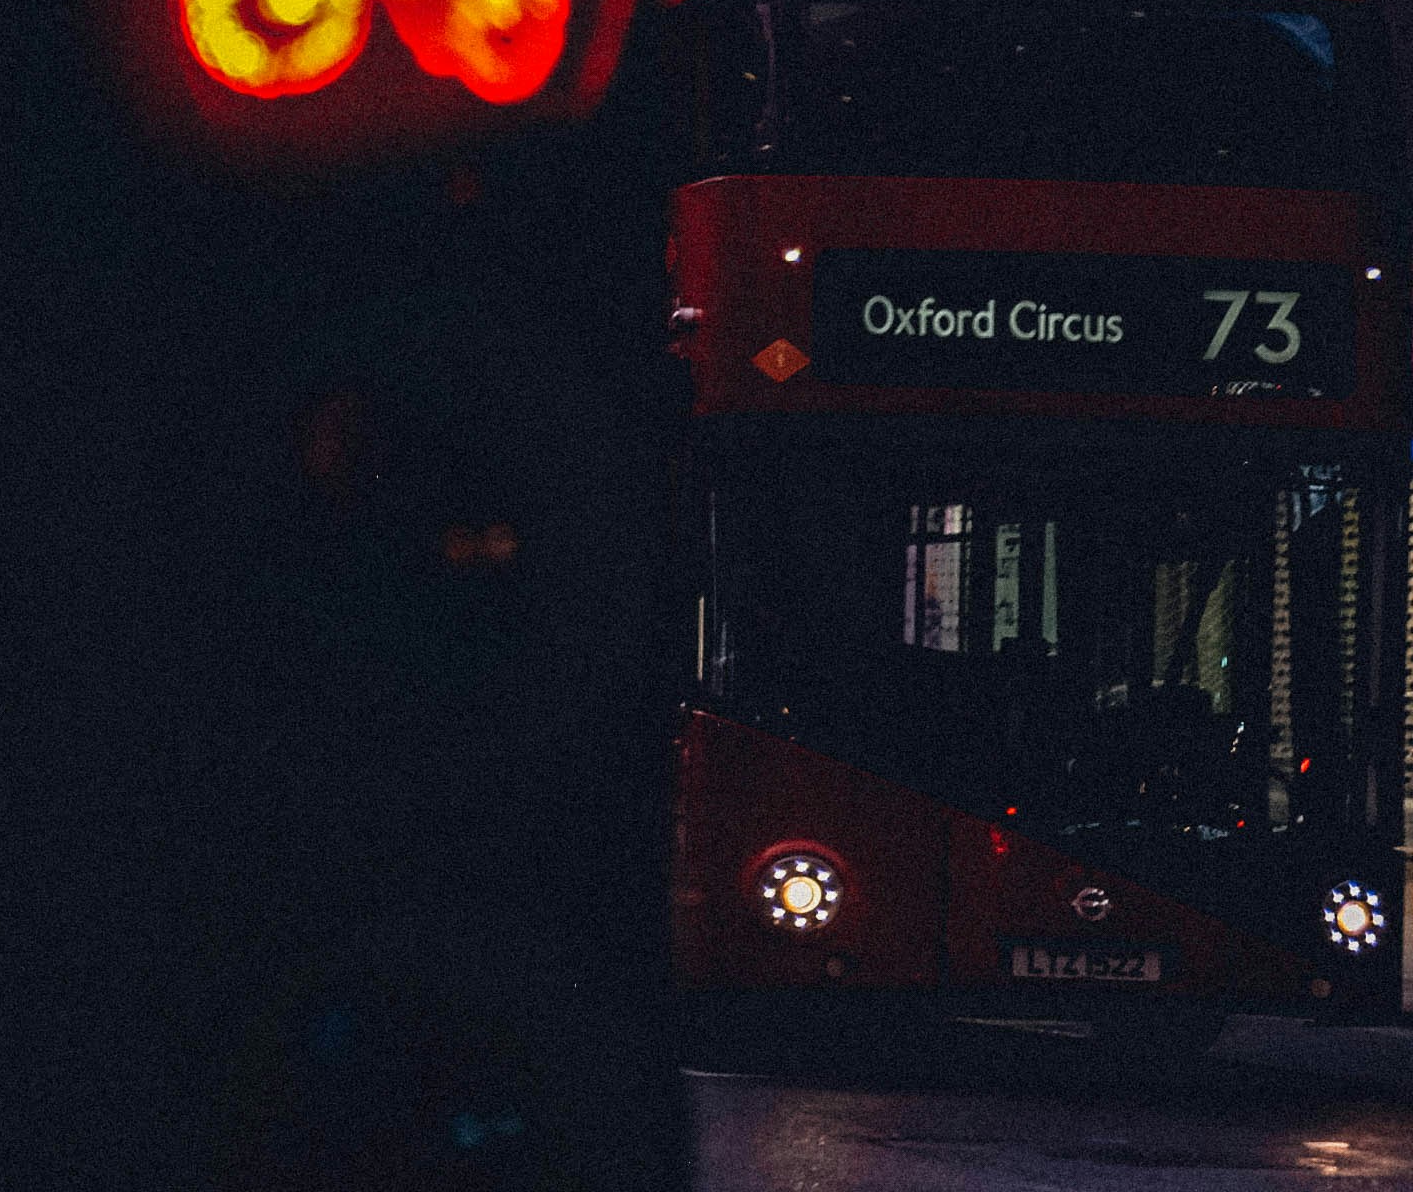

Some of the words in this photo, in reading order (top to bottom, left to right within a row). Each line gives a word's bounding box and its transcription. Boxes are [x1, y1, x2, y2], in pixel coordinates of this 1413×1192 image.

[862, 294, 995, 339] Oxford
[1008, 299, 1125, 344] Circus
[1202, 289, 1302, 364] 73
